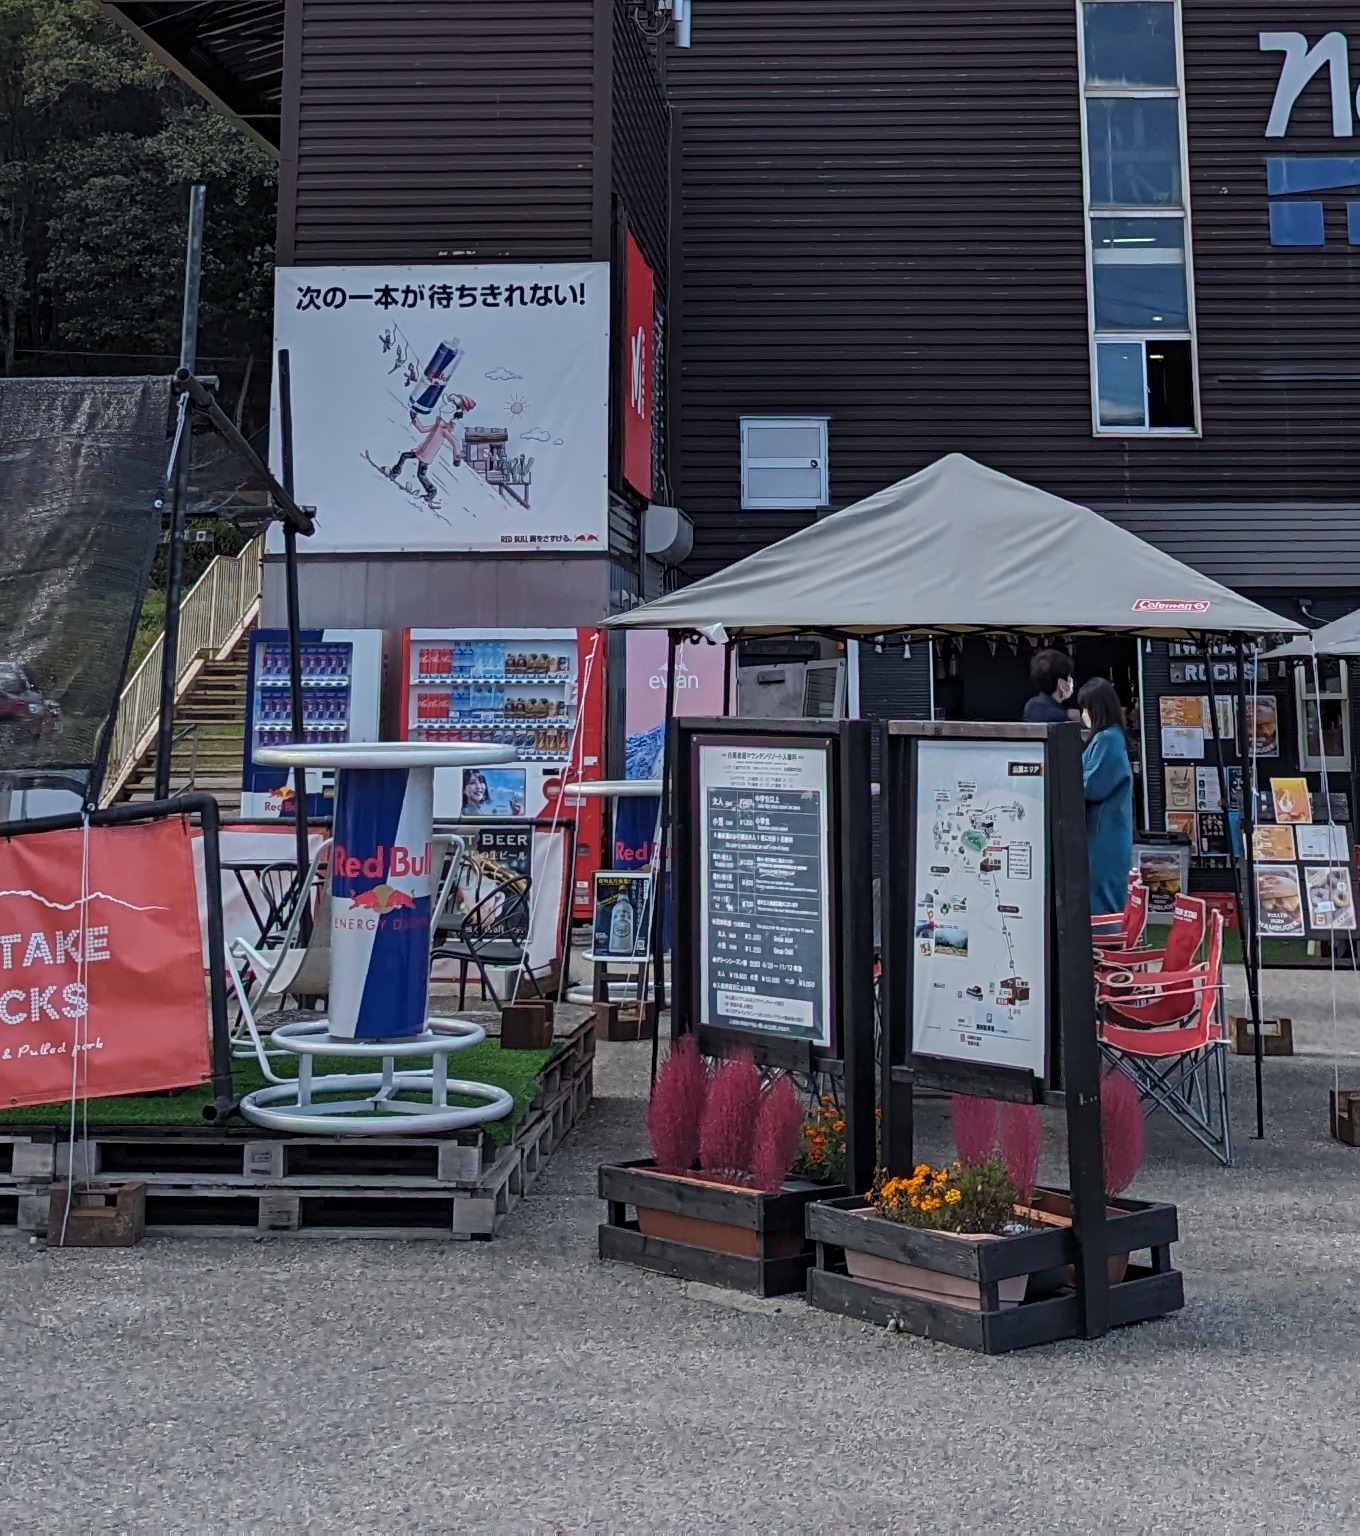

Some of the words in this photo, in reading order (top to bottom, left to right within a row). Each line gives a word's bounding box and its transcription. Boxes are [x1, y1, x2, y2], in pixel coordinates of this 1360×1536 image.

[649, 672, 699, 689] evan
[482, 834, 528, 846] BEER
[334, 845, 384, 878] Red
[390, 842, 432, 877] Bull
[616, 841, 648, 861] Red
[2, 1049, 12, 1059] &
[18, 1042, 66, 1058] Pulled
[72, 1037, 104, 1057] pork
